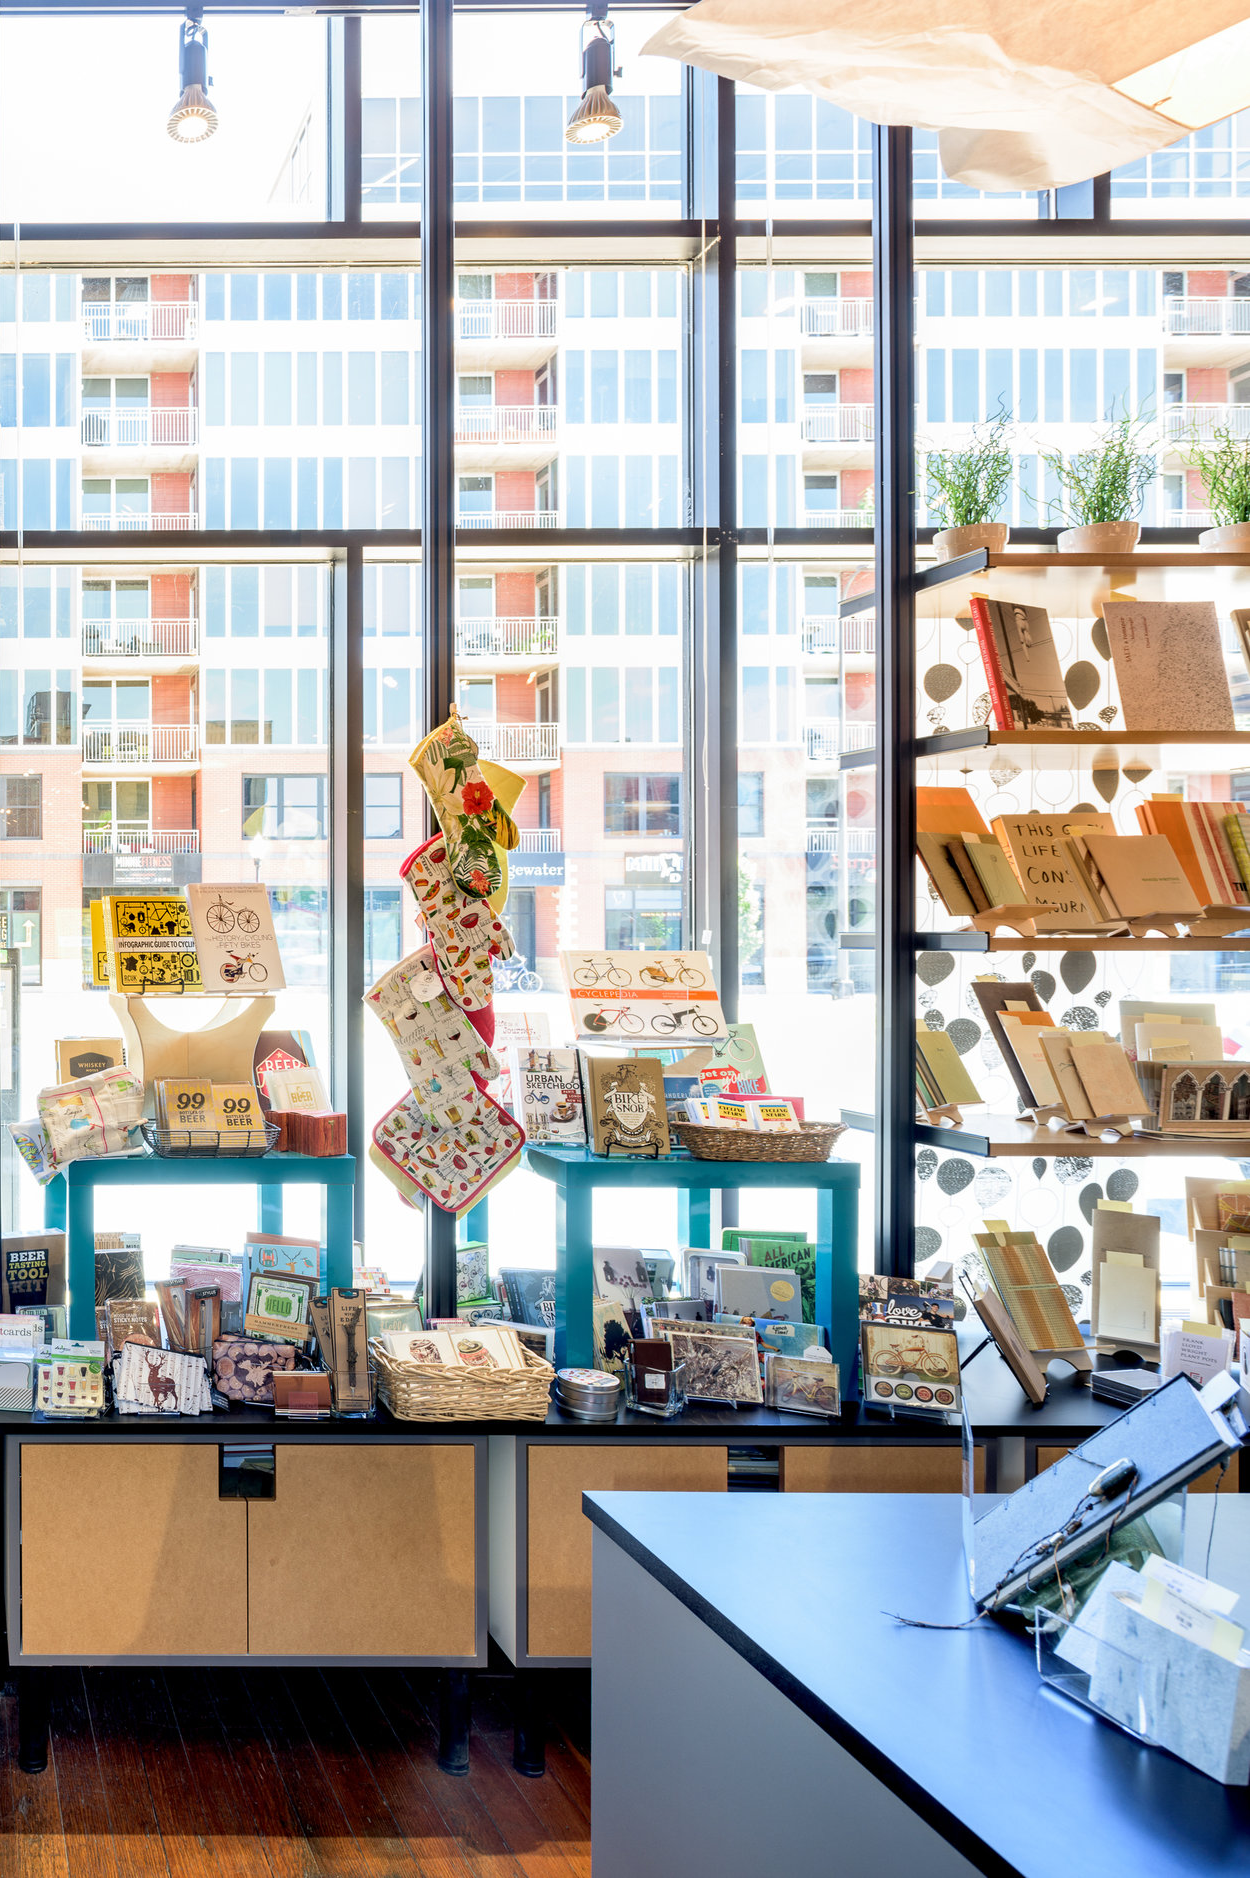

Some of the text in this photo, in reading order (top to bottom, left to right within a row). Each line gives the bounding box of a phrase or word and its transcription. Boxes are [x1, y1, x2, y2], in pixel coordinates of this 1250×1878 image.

[1014, 823, 1053, 837] THIS
[1022, 845, 1061, 857] LIFE
[508, 862, 564, 880] gewater
[578, 990, 638, 998] CYCLEPEDIA
[265, 1060, 302, 1071] BEER
[526, 1075, 563, 1083] URBAN
[701, 1070, 717, 1079] get
[736, 1079, 761, 1094] BIKE
[176, 1093, 206, 1109] 99
[614, 1093, 645, 1104] BIKE
[222, 1098, 251, 1113] 99
[616, 1104, 645, 1113] SNOB
[179, 1115, 207, 1124] BEER
[226, 1118, 253, 1126] BEER
[10, 1251, 45, 1263] BEER
[764, 1245, 785, 1262] ALL
[9, 1260, 47, 1269] TASTING
[7, 1268, 48, 1281] TOOL
[12, 1281, 44, 1294] KIT
[267, 1299, 291, 1314] HELLO
[873, 1299, 922, 1319] I love
[1182, 1337, 1204, 1345] FRANK
[1181, 1348, 1207, 1356] WRIGHT
[1180, 1353, 1200, 1361] PLANT
[1202, 1356, 1218, 1364] POTS
